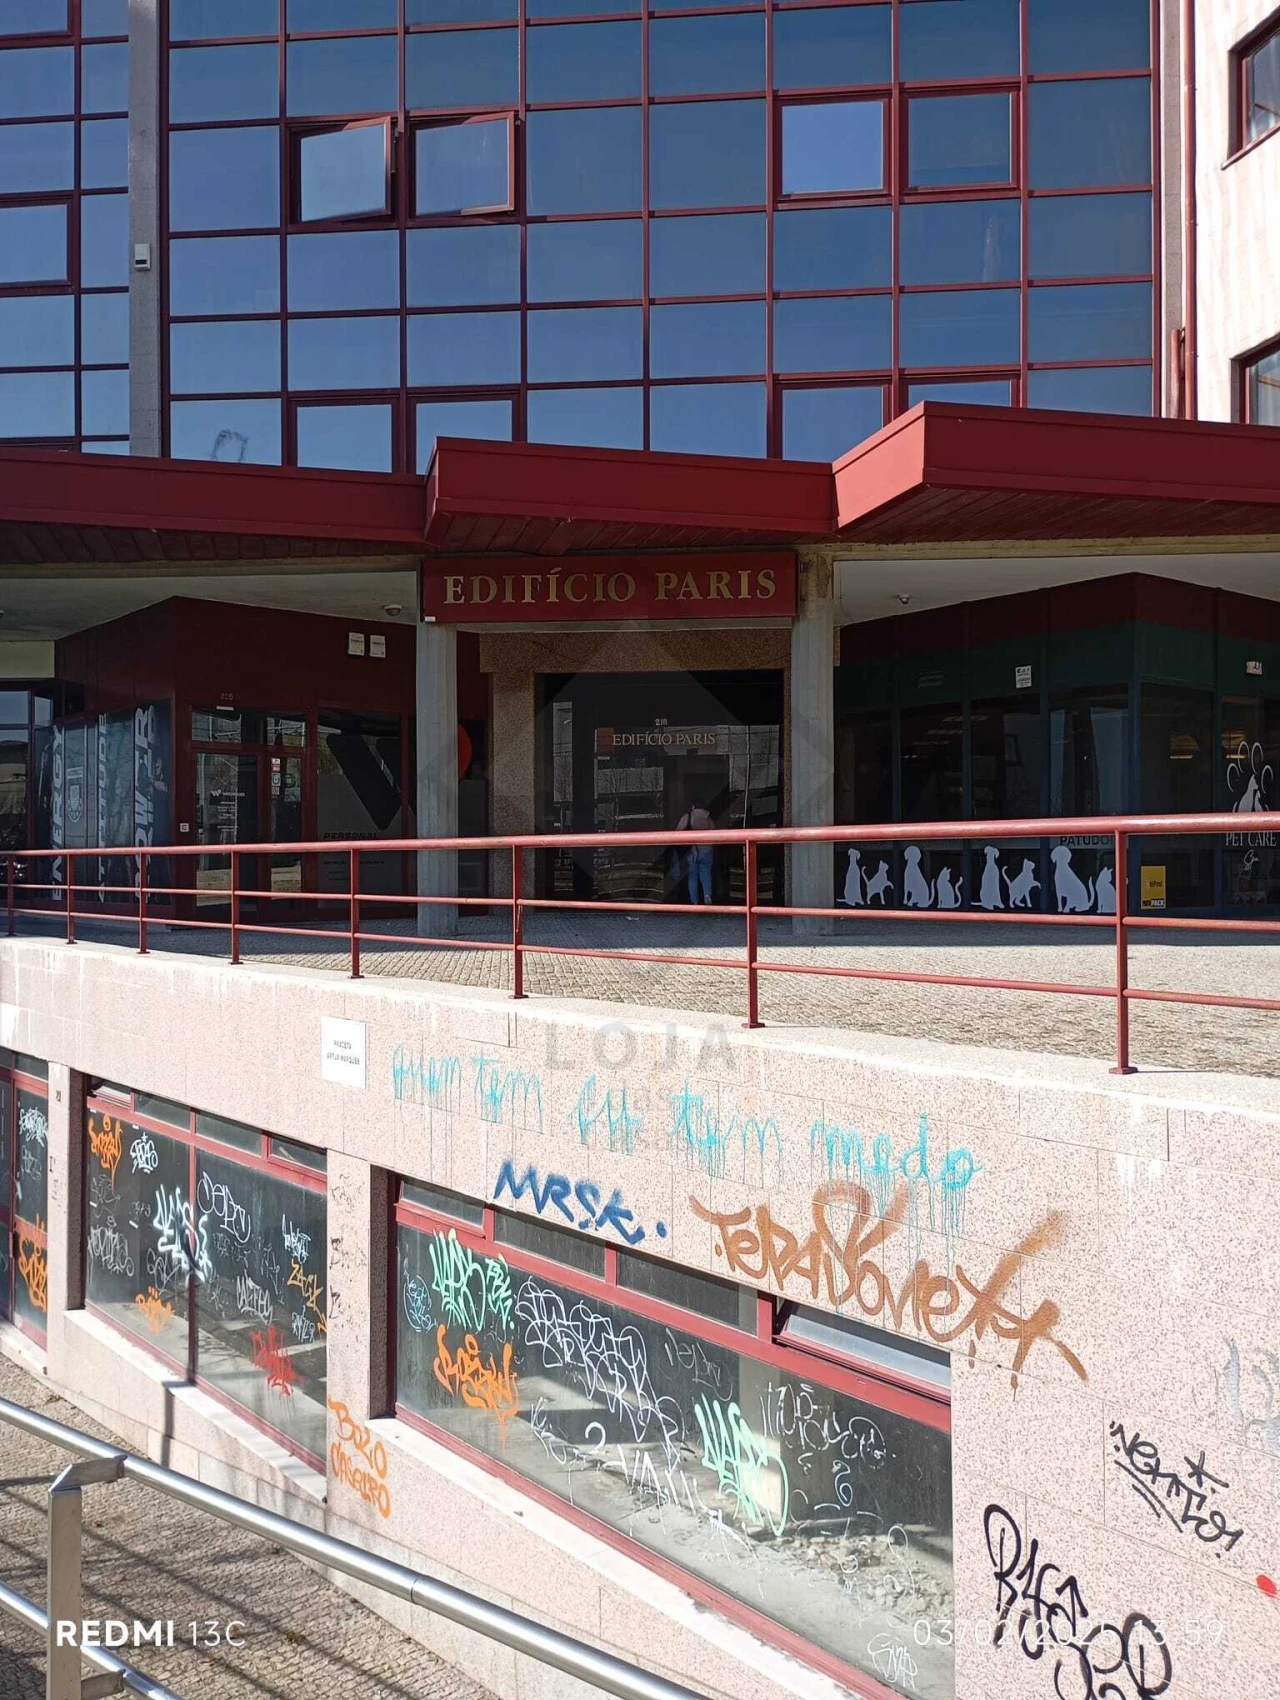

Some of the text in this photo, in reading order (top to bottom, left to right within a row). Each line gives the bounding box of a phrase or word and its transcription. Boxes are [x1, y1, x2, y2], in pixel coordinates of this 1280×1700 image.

[443, 567, 776, 604] EDIFÍCIO PARIS
[612, 731, 716, 746] EDIFÍCIO PARIS
[1247, 831, 1278, 847] CARE
